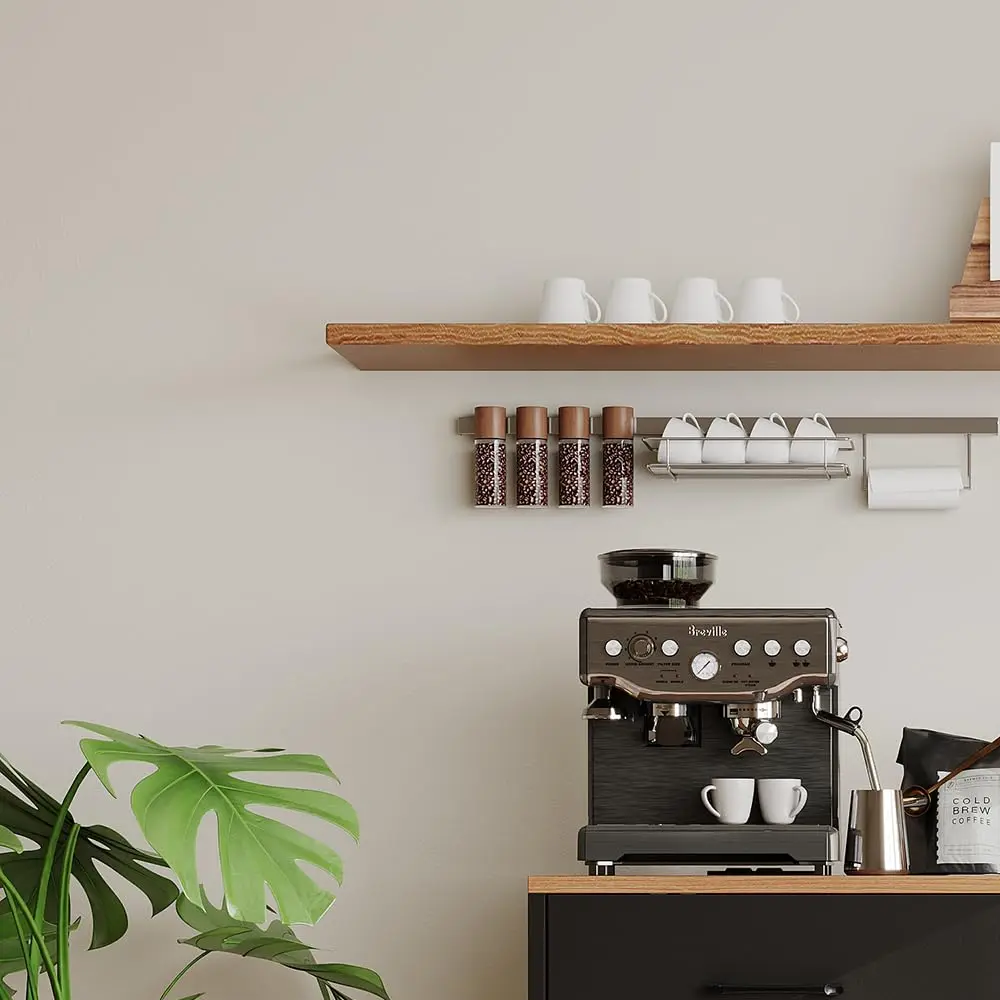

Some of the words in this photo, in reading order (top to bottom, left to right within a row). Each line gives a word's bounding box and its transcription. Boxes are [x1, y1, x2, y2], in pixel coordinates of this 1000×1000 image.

[688, 624, 728, 637] Breville
[953, 806, 990, 815] BREW
[952, 816, 990, 825] COFFEE
